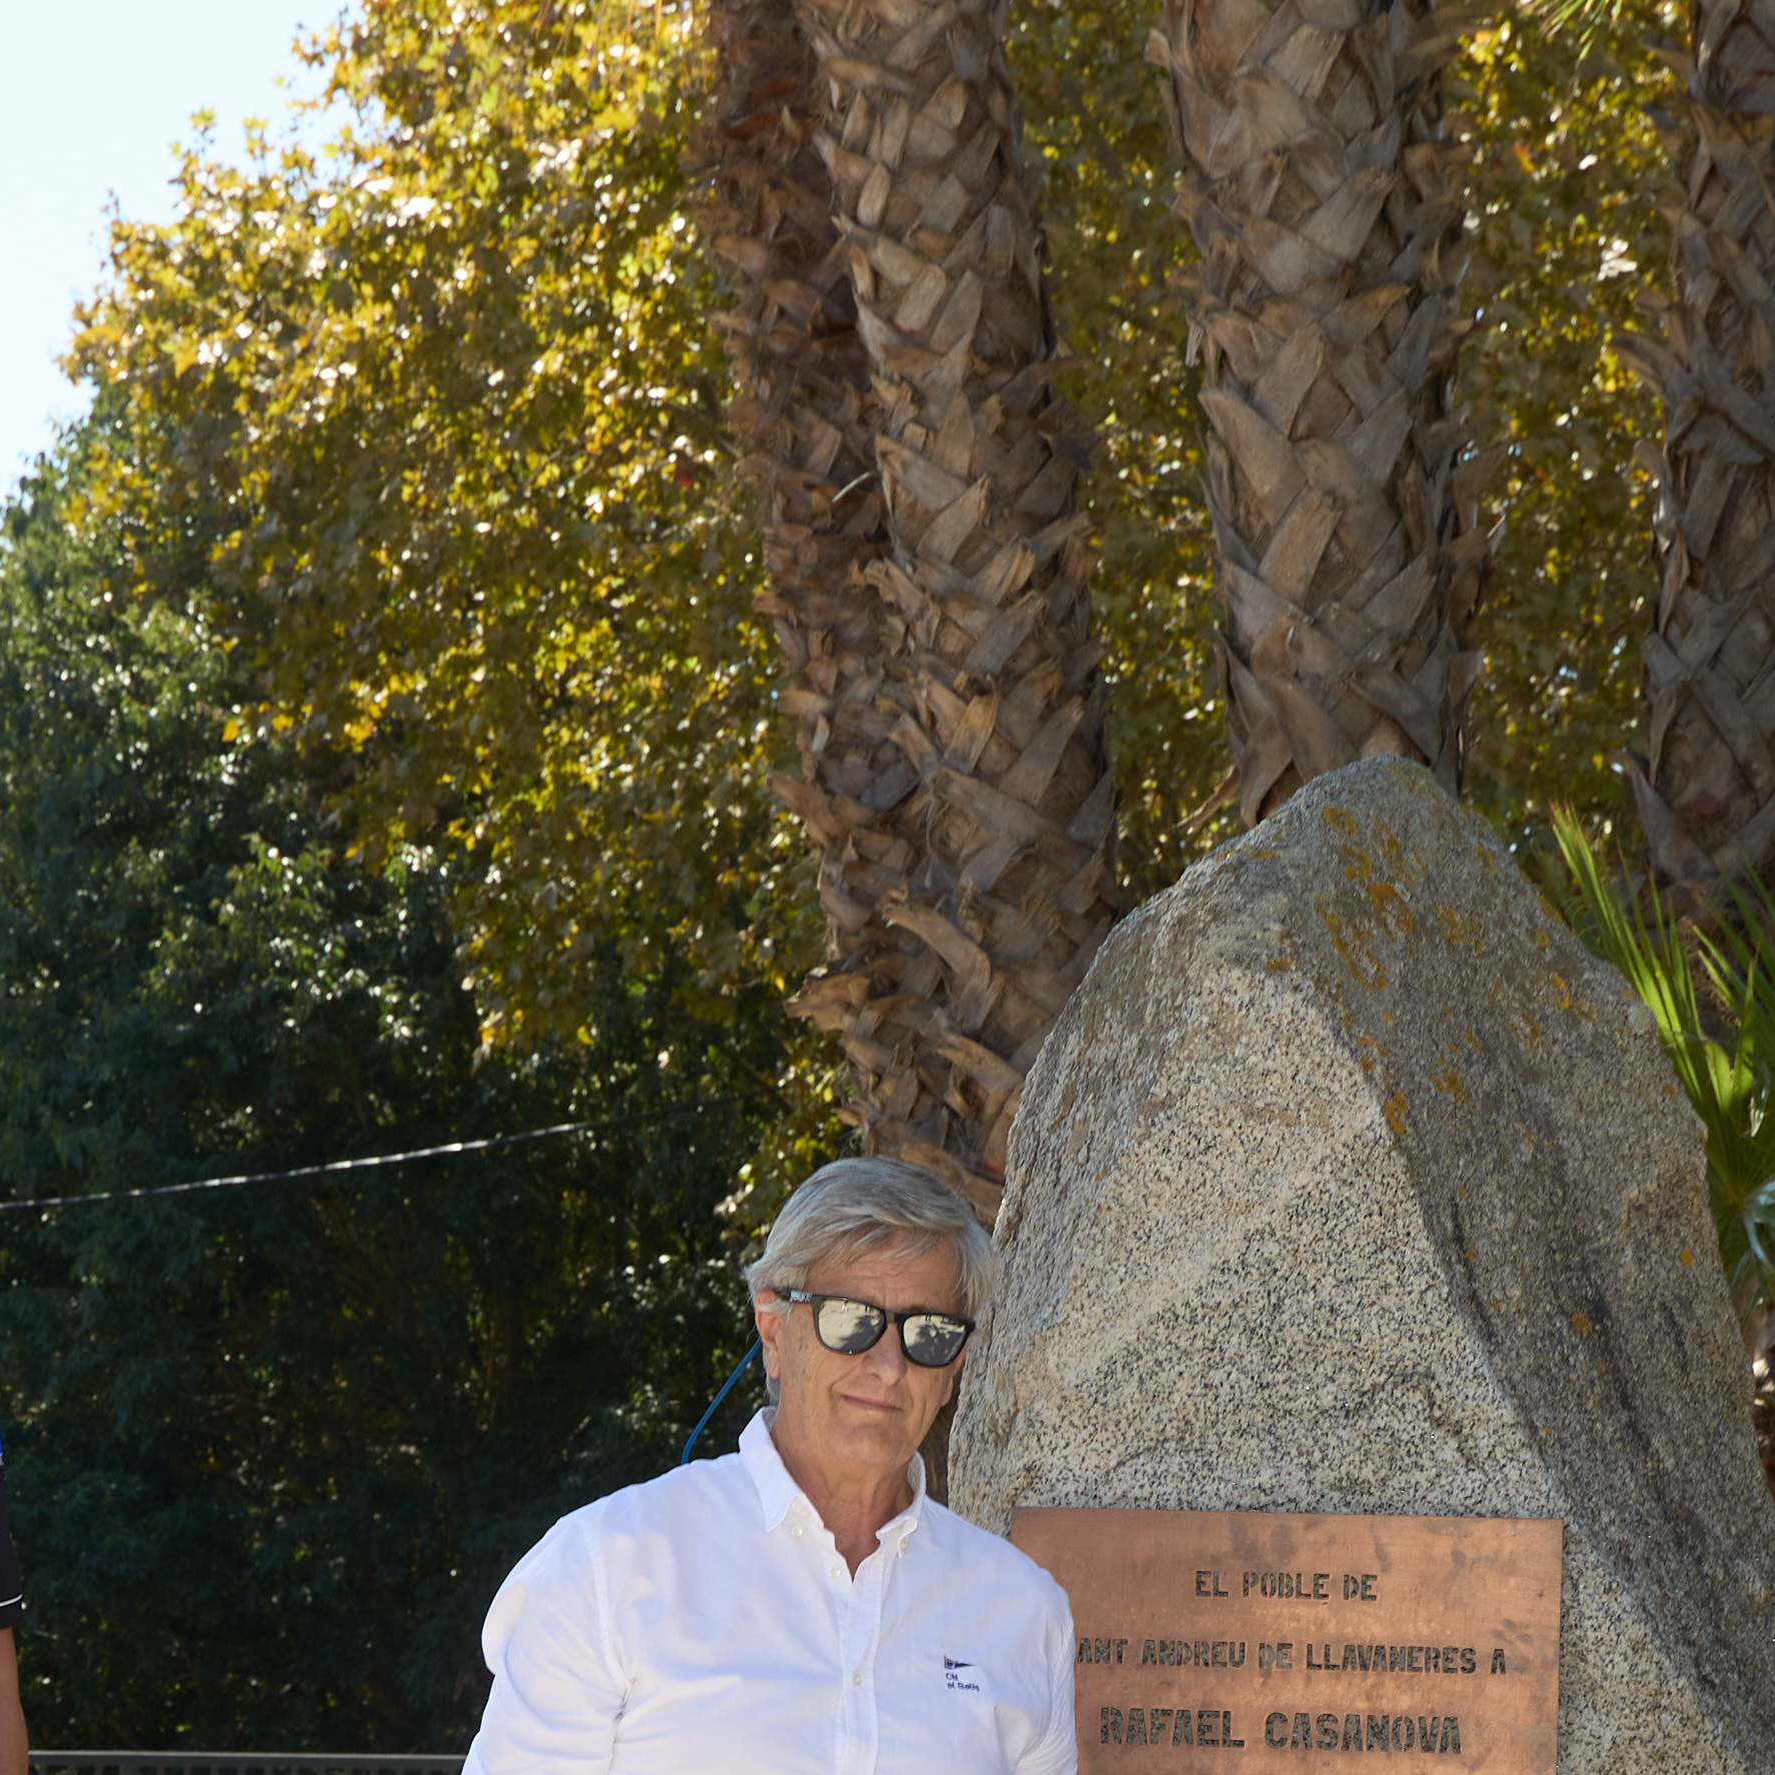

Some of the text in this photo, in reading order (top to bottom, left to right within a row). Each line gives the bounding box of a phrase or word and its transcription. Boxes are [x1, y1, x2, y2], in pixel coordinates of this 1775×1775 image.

[1195, 1570, 1378, 1601] EL POBLE DE
[1077, 1638, 1507, 1676] ANT ANDREU DE LLAVANERES A
[1100, 1707, 1462, 1754] RAFAEL CASANOVA
